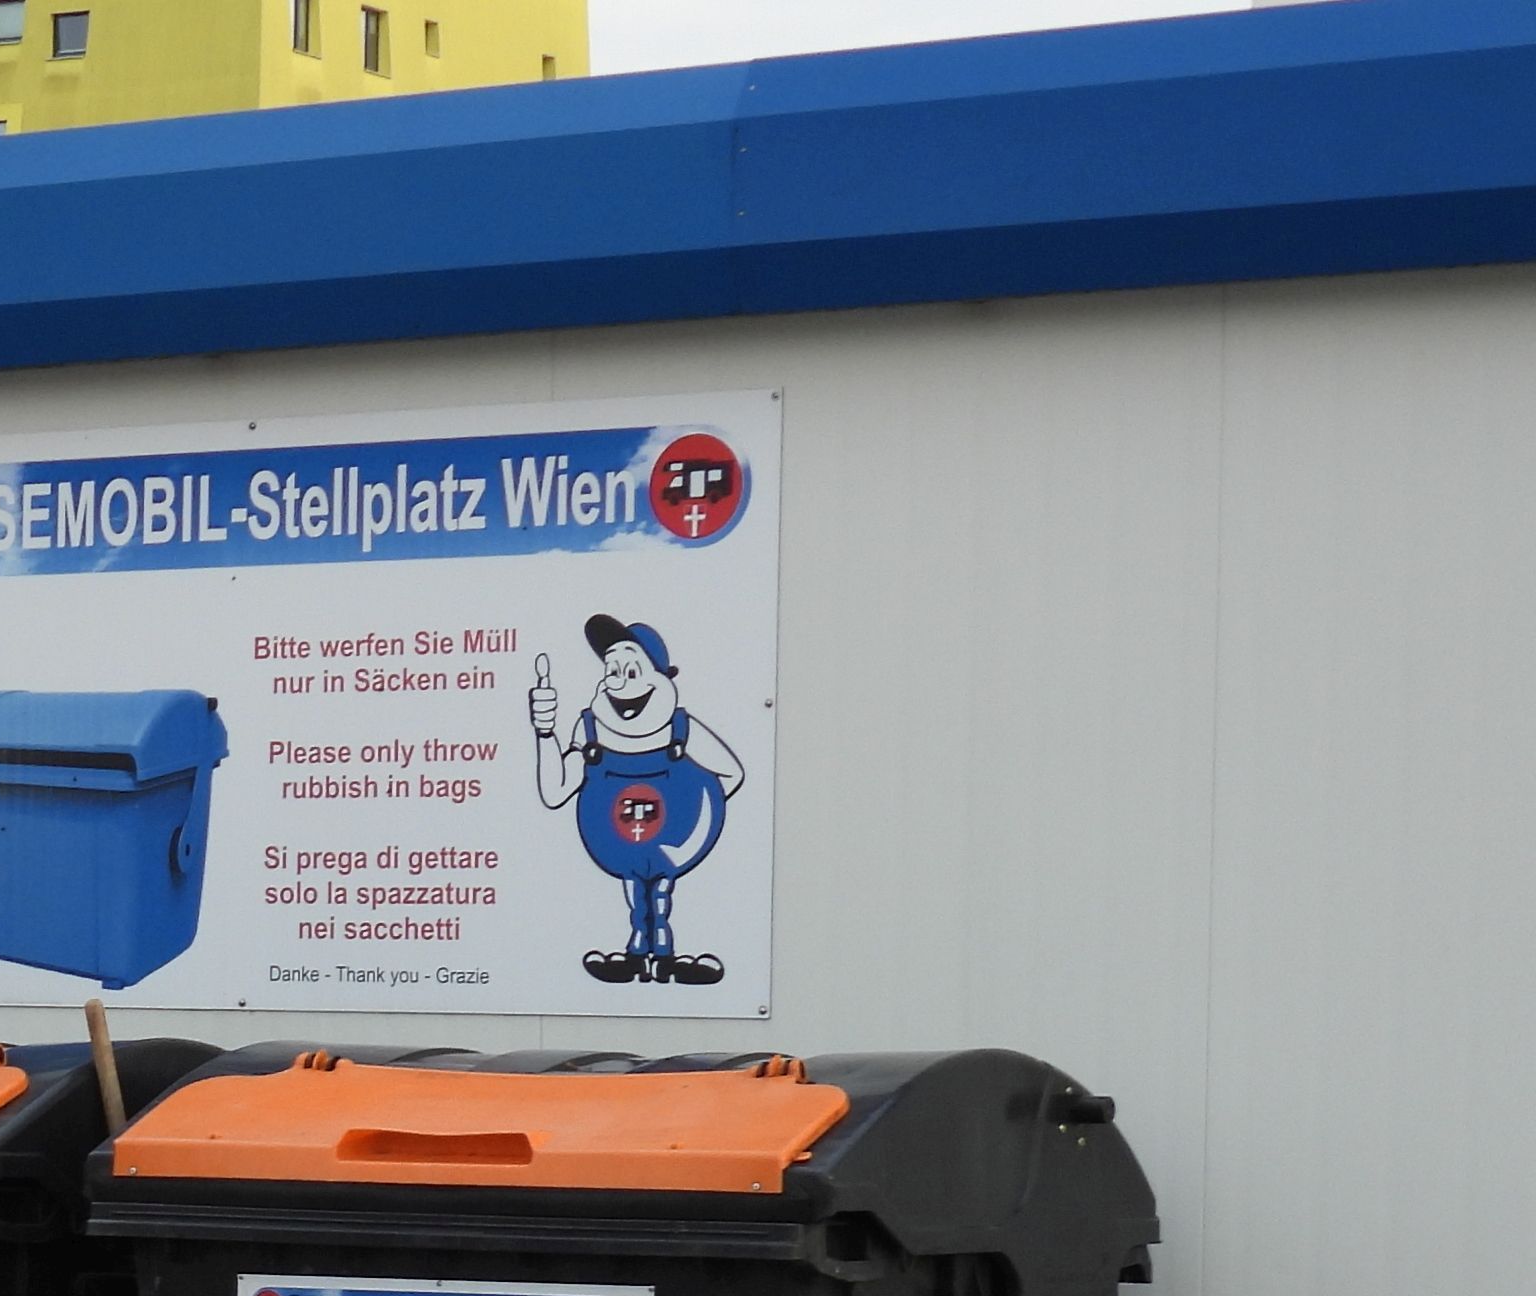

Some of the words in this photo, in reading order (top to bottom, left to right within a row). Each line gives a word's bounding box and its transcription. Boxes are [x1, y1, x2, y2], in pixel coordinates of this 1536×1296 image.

[501, 455, 635, 528] Wien
[254, 636, 310, 659] Bitte
[320, 633, 404, 657] werfen
[414, 630, 453, 655] Sie
[463, 628, 516, 653] Müll
[273, 676, 315, 694] nur
[323, 670, 344, 693] in
[355, 667, 447, 692] Säcken
[457, 666, 495, 690] ein
[269, 741, 351, 764] Please
[361, 739, 414, 768] only
[424, 738, 498, 762] throw
[282, 775, 378, 799] rubbish
[387, 775, 409, 798] in
[420, 774, 481, 803] bags
[264, 846, 287, 869] Si
[297, 850, 367, 875] prega
[377, 846, 399, 869] di
[408, 847, 499, 875] gettare
[265, 881, 318, 904] solo
[328, 881, 347, 904] la
[356, 882, 497, 910] spazzatura
[299, 917, 335, 939] nei
[344, 917, 460, 940] sacchetti
[269, 965, 319, 982] Danke
[336, 966, 384, 983] Thank
[390, 971, 419, 987] you
[436, 967, 490, 984] Grazie
